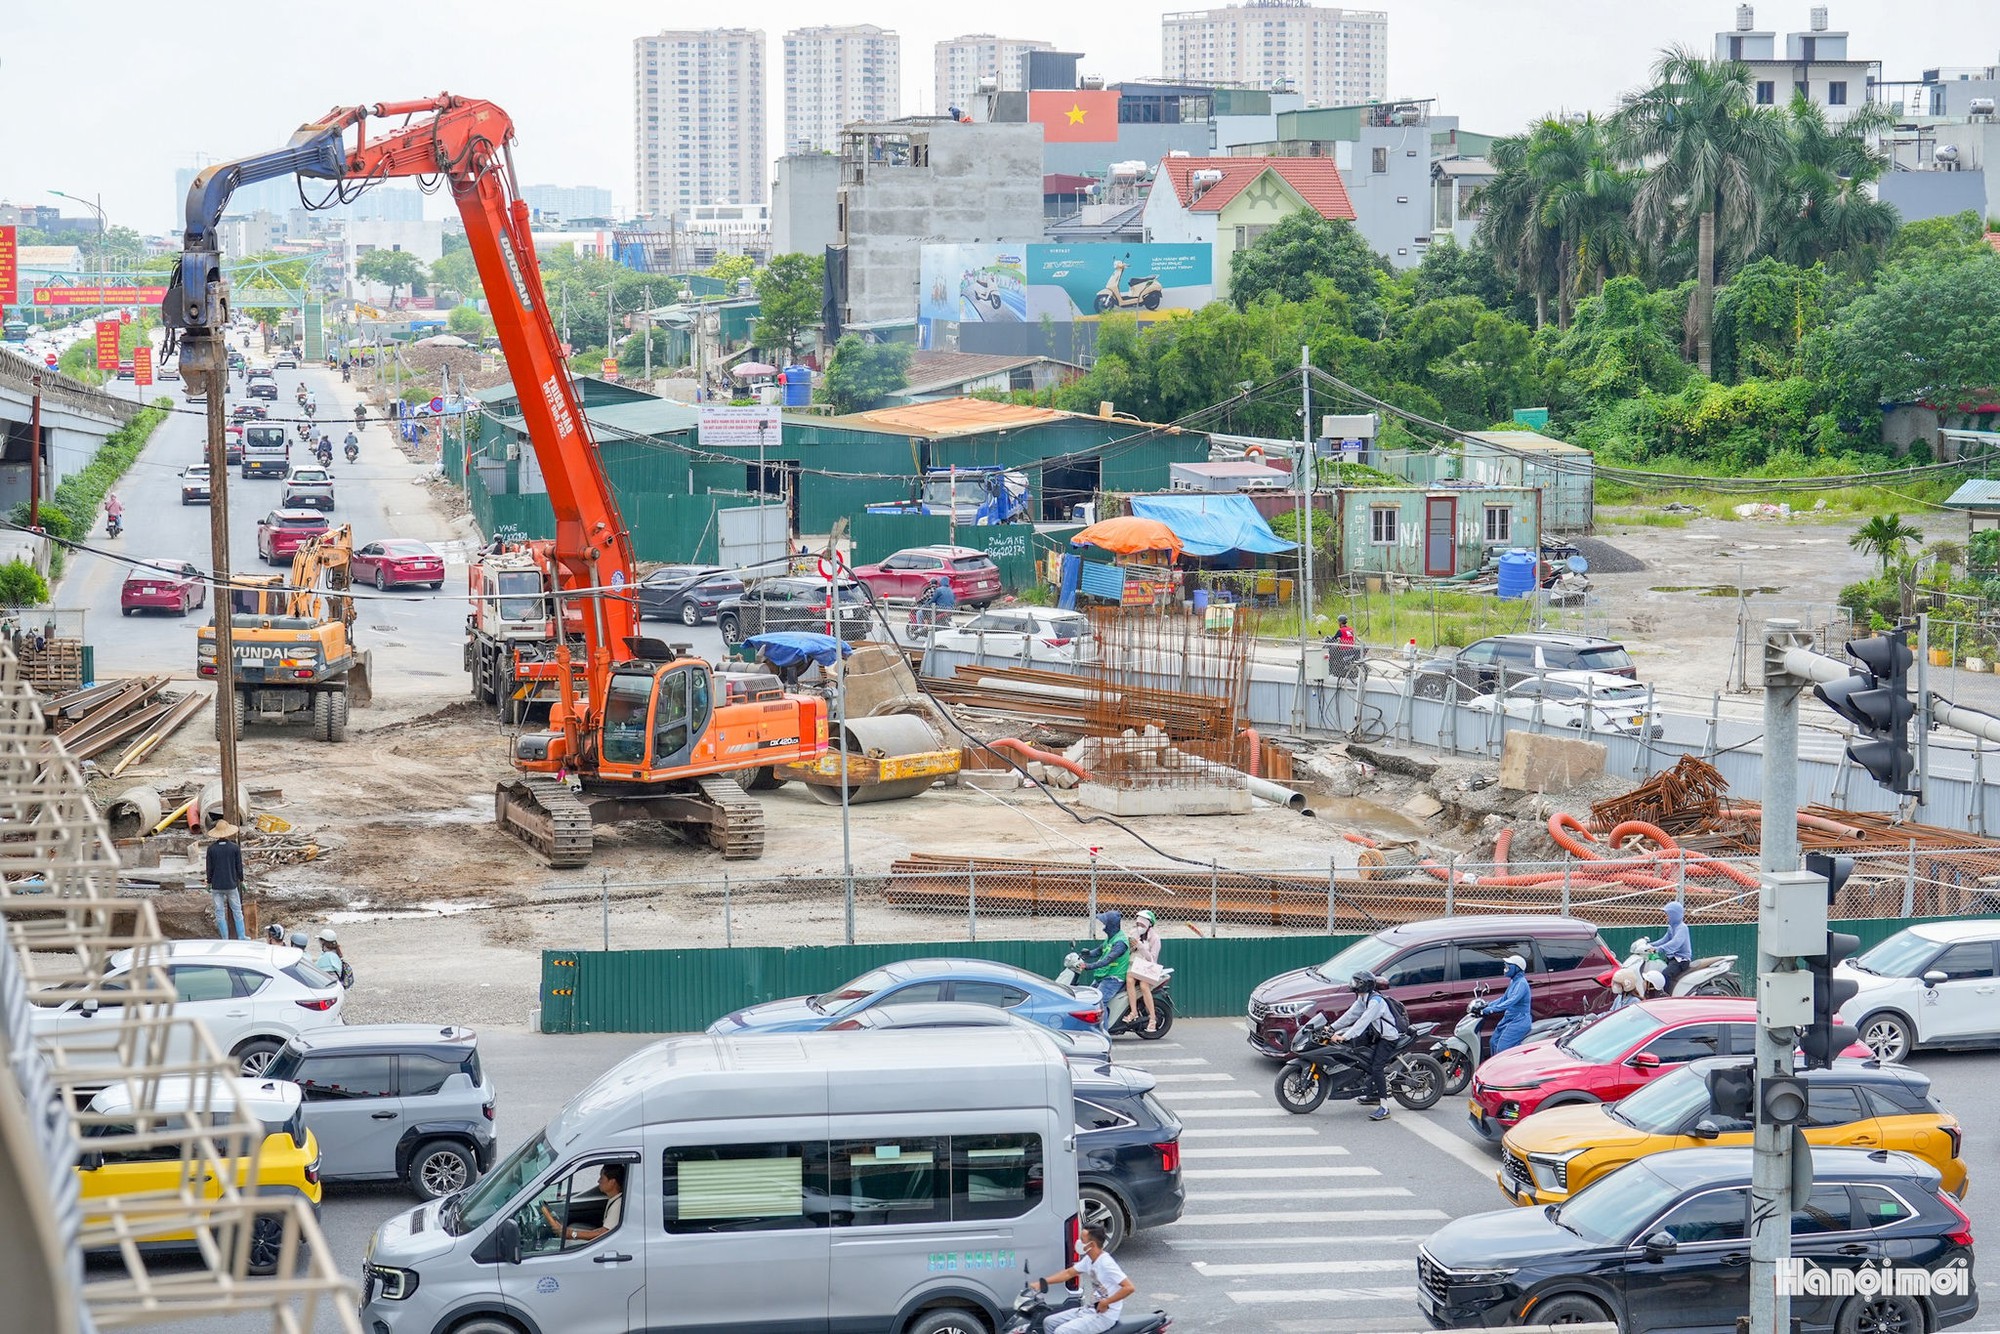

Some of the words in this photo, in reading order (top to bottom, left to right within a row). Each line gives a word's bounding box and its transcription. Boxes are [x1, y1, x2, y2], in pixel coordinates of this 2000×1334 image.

[500, 235, 532, 307] DOOSAN
[548, 374, 566, 410] THIÊN
[231, 646, 289, 660] YUNDAI
